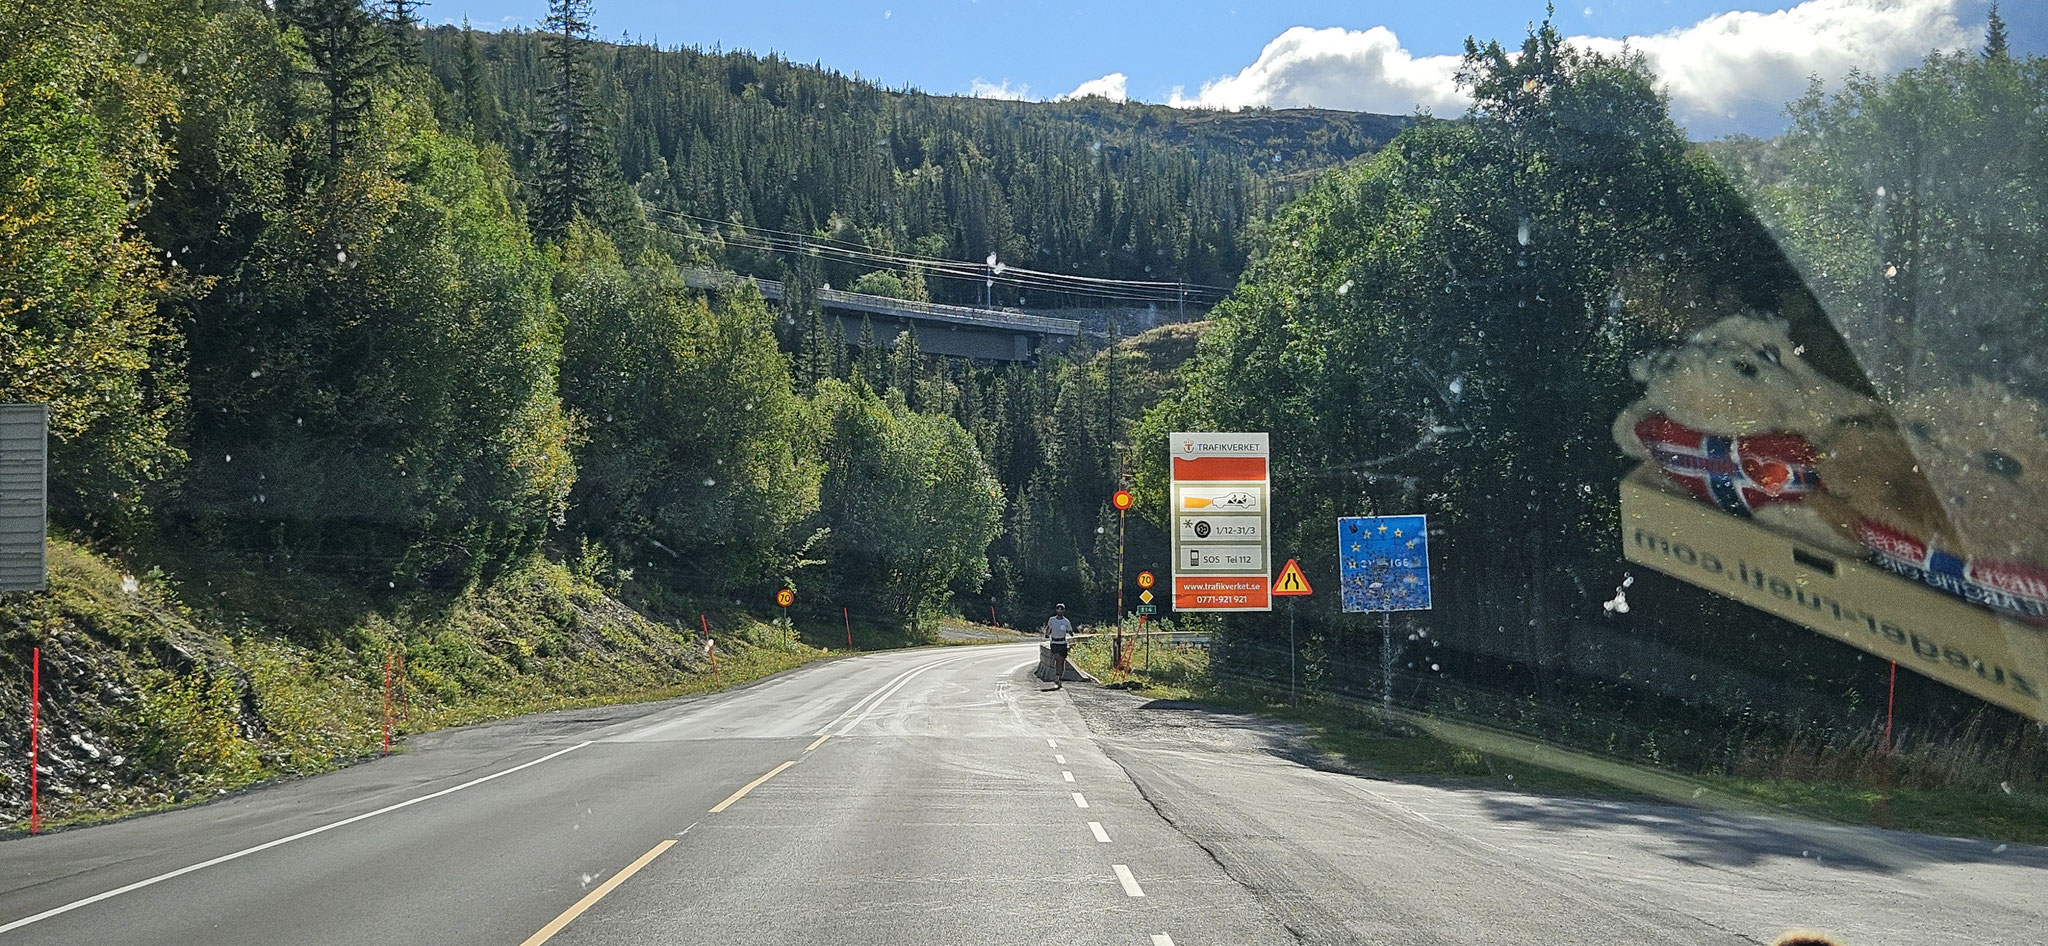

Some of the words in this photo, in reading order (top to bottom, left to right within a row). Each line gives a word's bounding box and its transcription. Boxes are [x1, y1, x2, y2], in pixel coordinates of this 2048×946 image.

[1197, 443, 1260, 452] TRAFIKVERKET
[1215, 526, 1256, 535] 1/12-31/3
[1203, 555, 1220, 564] SOS
[1226, 555, 1238, 564] Tel
[1239, 555, 1252, 564] 112
[1141, 575, 1152, 584] 70
[1183, 583, 1261, 591] www.trafikverket.se
[780, 594, 791, 603] 70
[1196, 595, 1232, 604] 0771-921
[1233, 595, 1248, 604] 921
